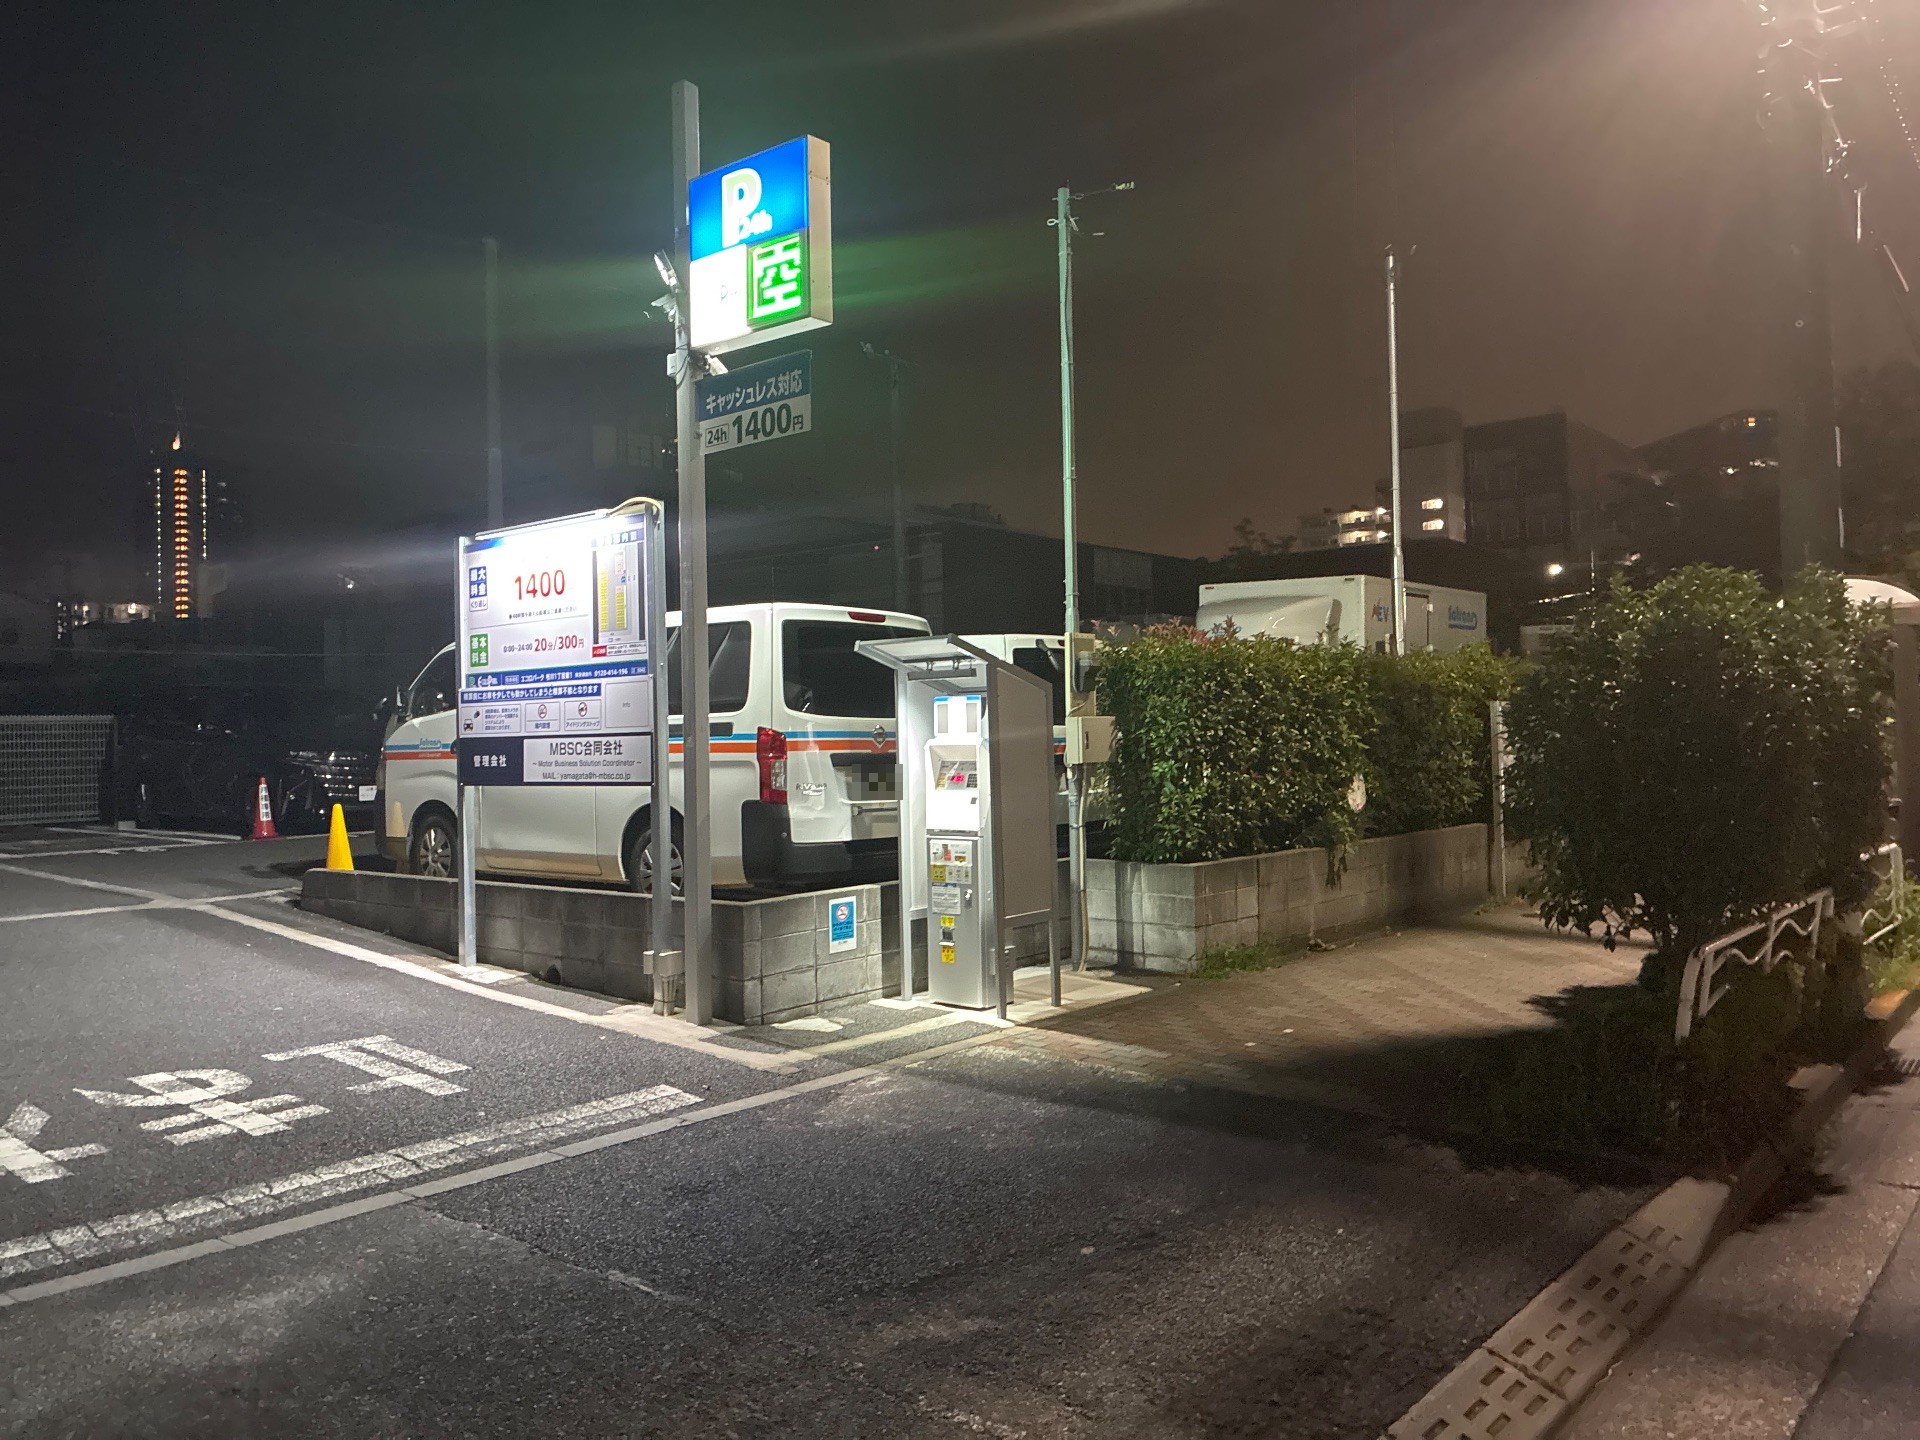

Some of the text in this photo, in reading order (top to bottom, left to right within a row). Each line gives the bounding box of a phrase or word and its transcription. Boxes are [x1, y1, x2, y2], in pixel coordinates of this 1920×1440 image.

[722, 168, 763, 249] P
[752, 236, 802, 319] 空
[706, 368, 803, 415] キャッシュレス対応
[707, 426, 728, 445] 24h
[470, 582, 487, 597] 料金
[514, 569, 565, 601] 1400
[471, 636, 487, 649] 基本
[471, 651, 487, 665] 料金
[549, 740, 624, 756] MBSC合同会社
[473, 754, 507, 768] 管理会社
[538, 759, 635, 768] Motor Business Solution Coordinator
